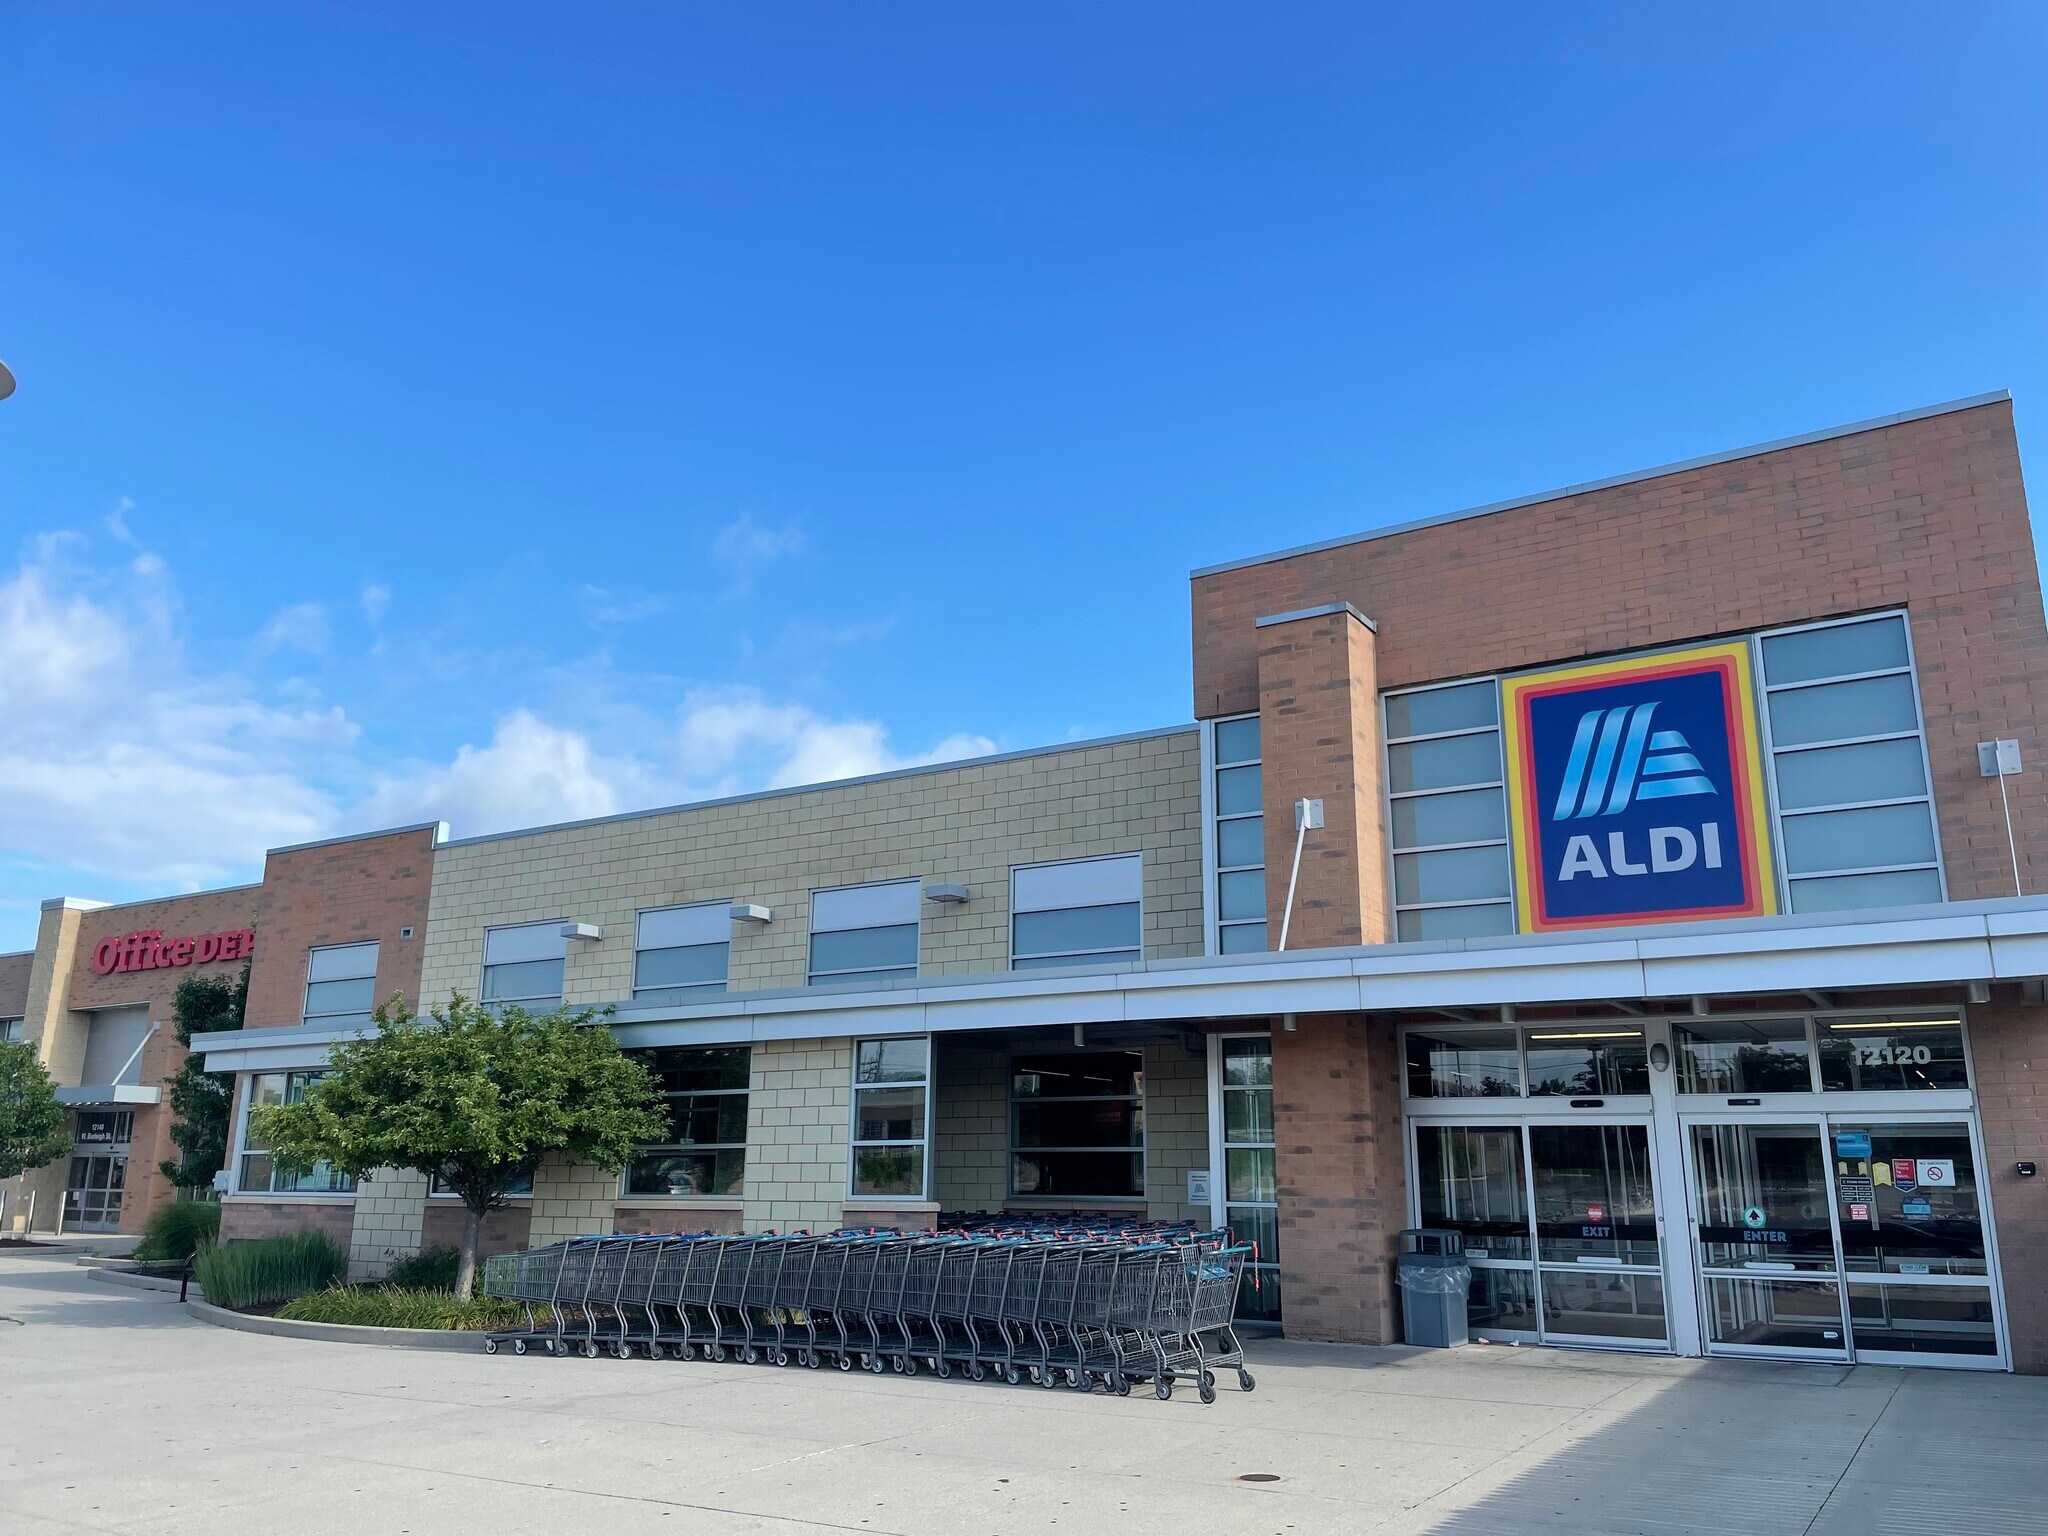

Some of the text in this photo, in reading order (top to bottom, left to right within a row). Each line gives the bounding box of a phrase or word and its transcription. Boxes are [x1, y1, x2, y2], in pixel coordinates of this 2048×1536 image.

[1557, 822, 1722, 882] ALDI
[92, 930, 196, 975] Office
[1851, 1045, 1931, 1066] 12120
[1582, 1226, 1610, 1237] EXIT
[1743, 1230, 1787, 1242] ENTER
